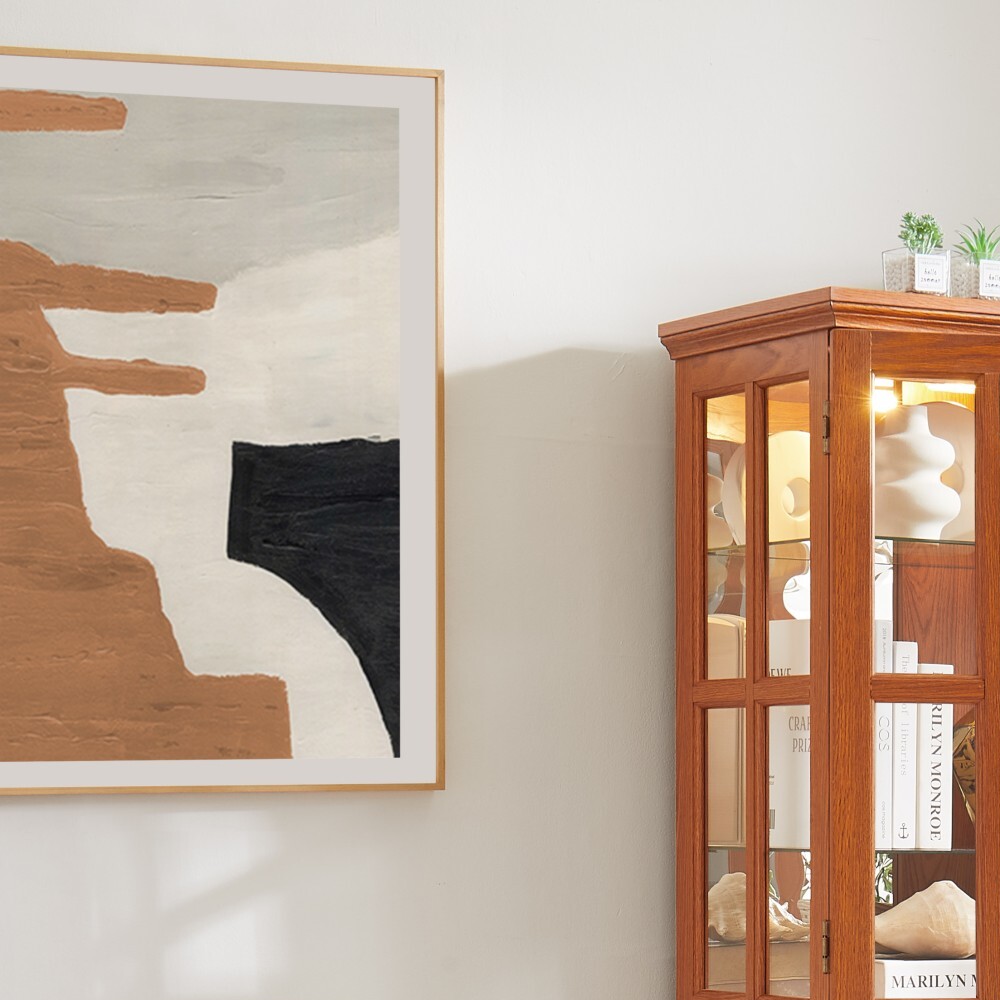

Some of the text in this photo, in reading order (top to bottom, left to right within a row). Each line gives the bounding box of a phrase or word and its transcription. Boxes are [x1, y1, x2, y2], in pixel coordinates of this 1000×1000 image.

[879, 716, 890, 752] COS
[901, 723, 910, 776] libraries
[930, 762, 942, 841] MONROE
[892, 974, 966, 988] MARILYN
